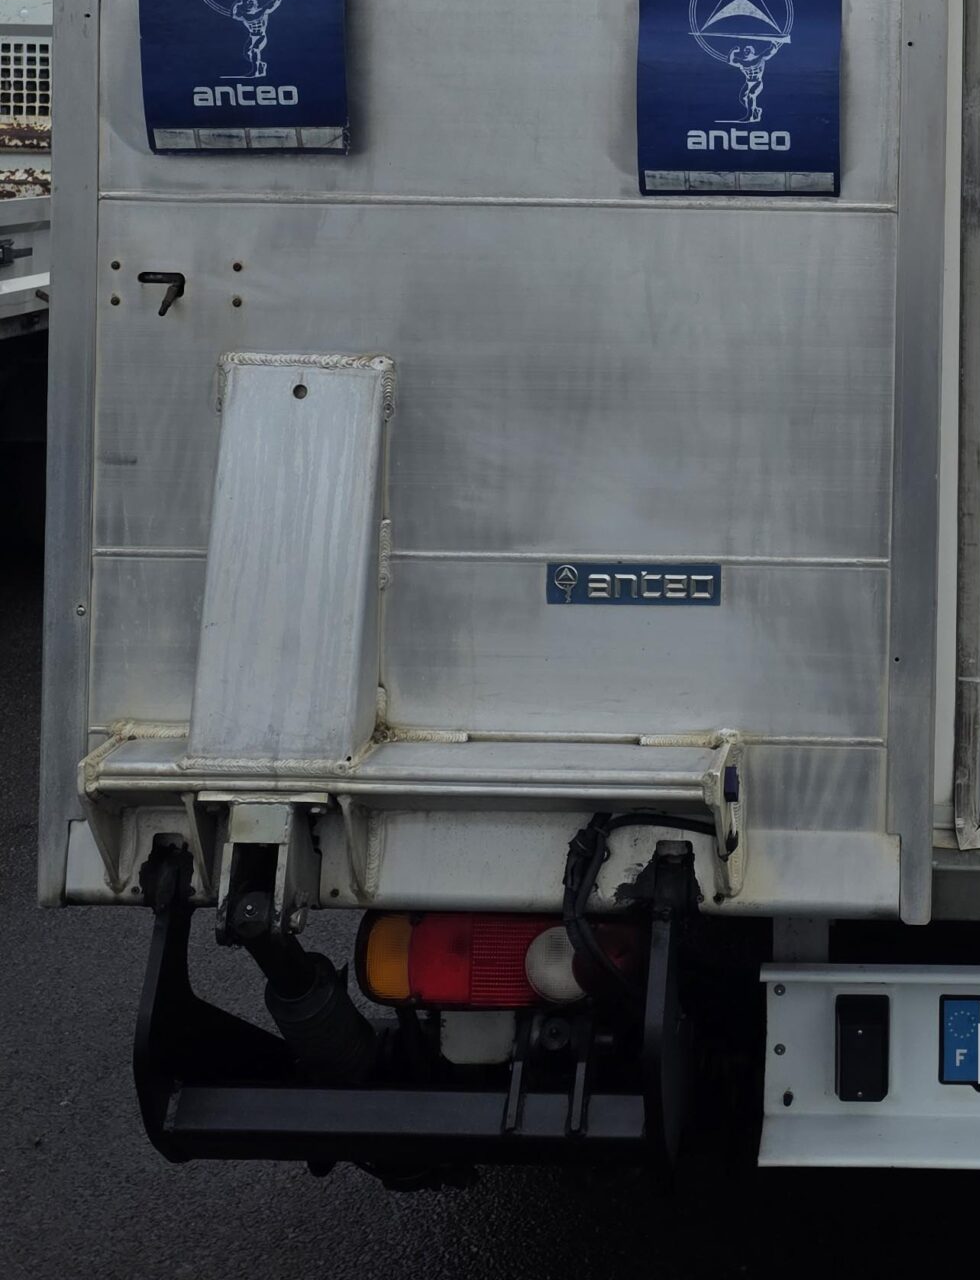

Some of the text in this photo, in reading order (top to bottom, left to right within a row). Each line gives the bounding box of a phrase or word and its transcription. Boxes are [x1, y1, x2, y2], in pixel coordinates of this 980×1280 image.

[193, 83, 299, 107] anteo
[686, 127, 791, 152] anteo
[587, 570, 714, 599] anteo
[955, 1049, 968, 1067] F
